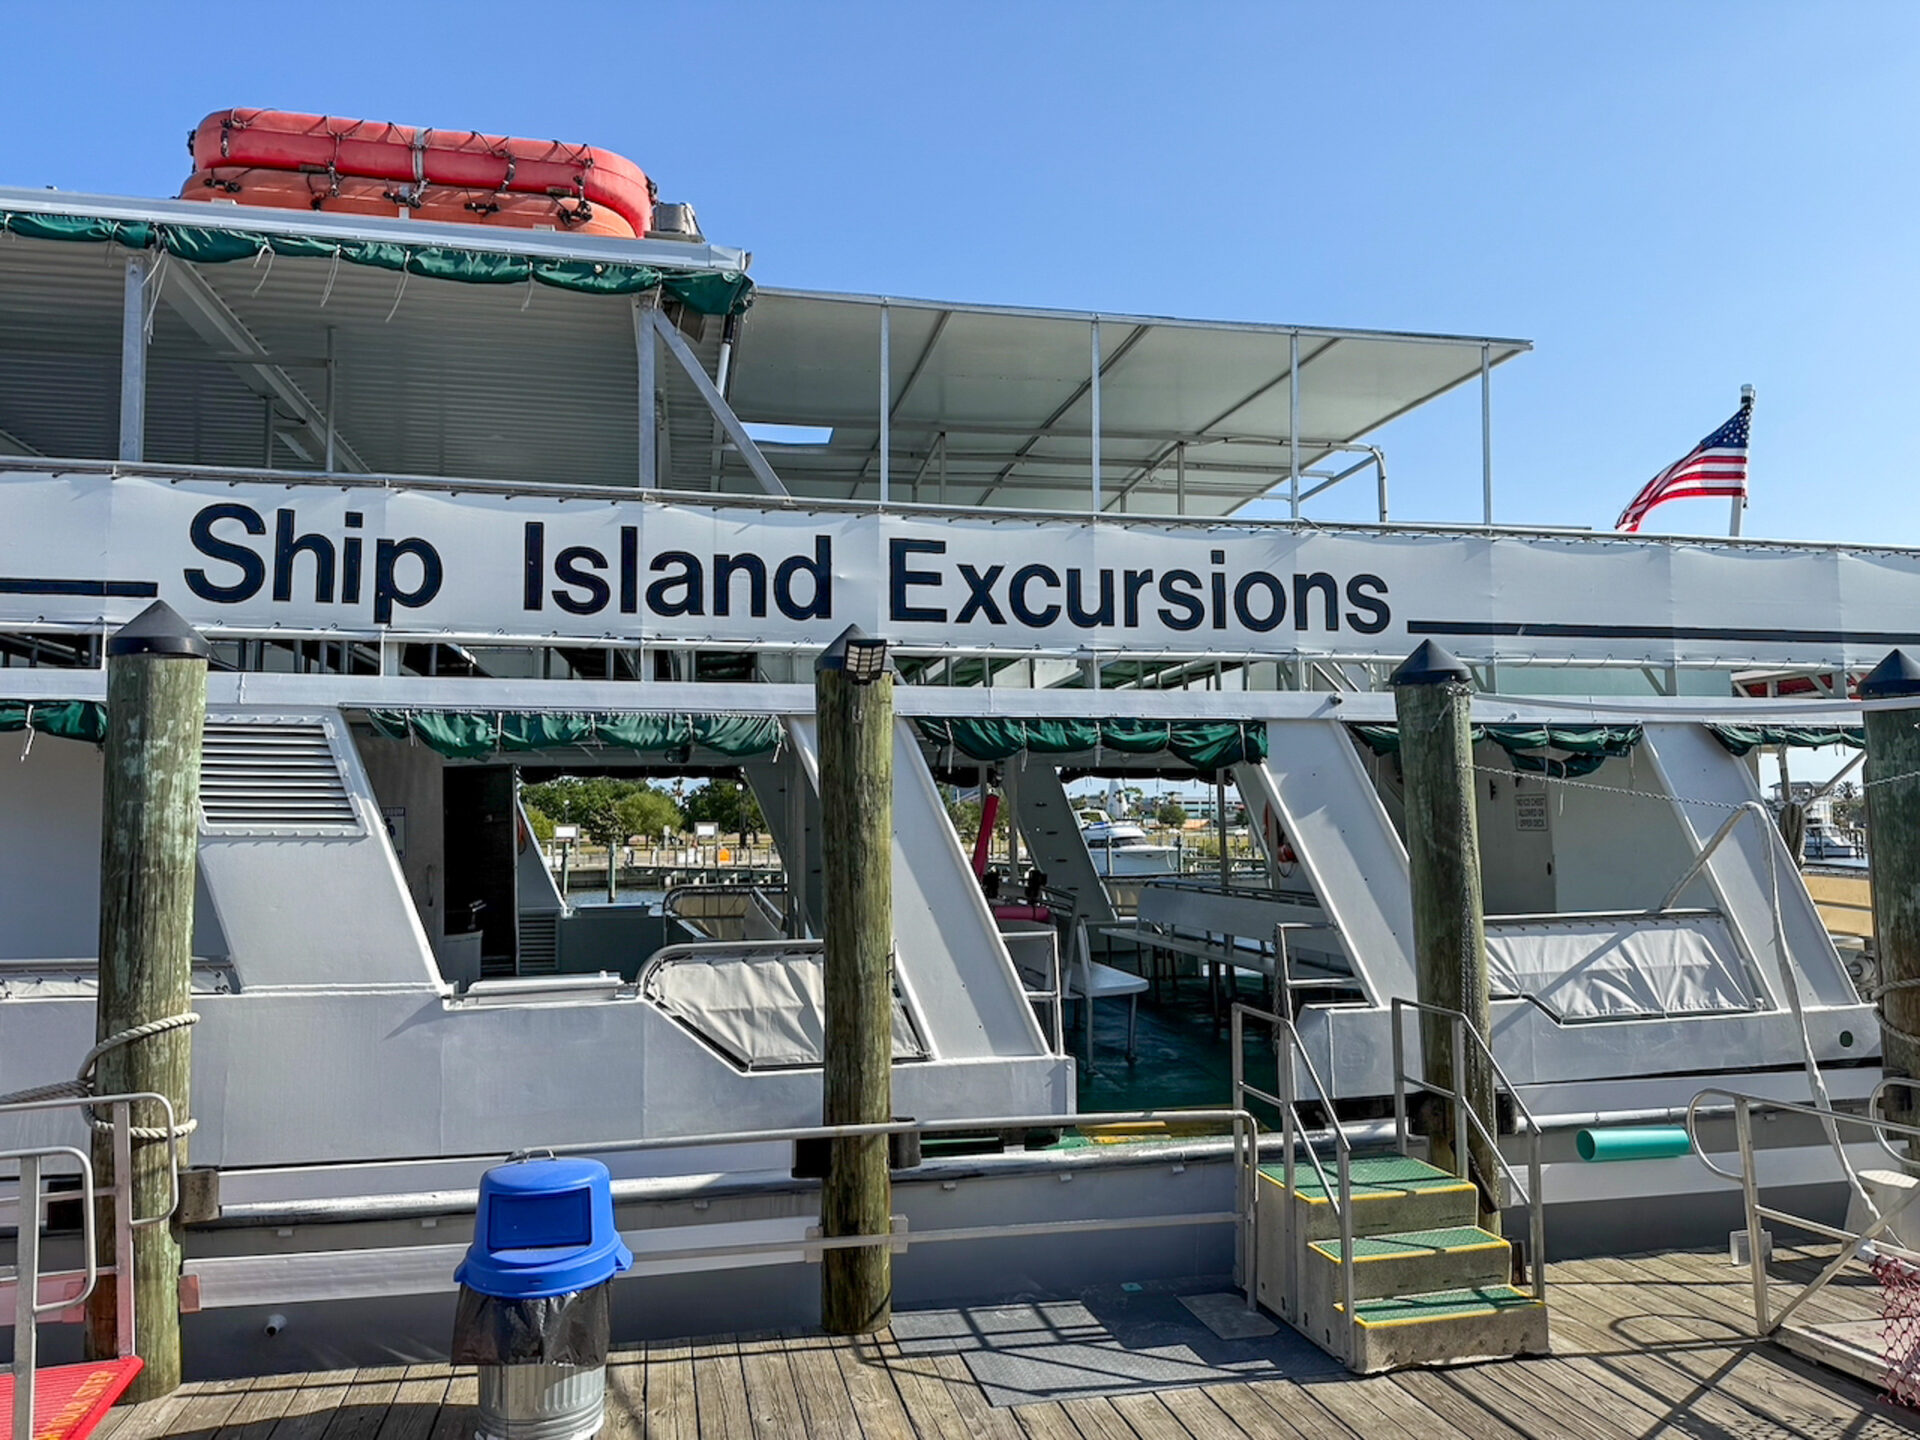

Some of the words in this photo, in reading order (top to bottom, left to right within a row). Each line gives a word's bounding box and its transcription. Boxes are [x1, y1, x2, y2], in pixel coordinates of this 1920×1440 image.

[183, 502, 443, 629] Ship
[523, 521, 832, 622] Island
[888, 537, 1391, 635] Excursions
[72, 1370, 118, 1399] STEP
